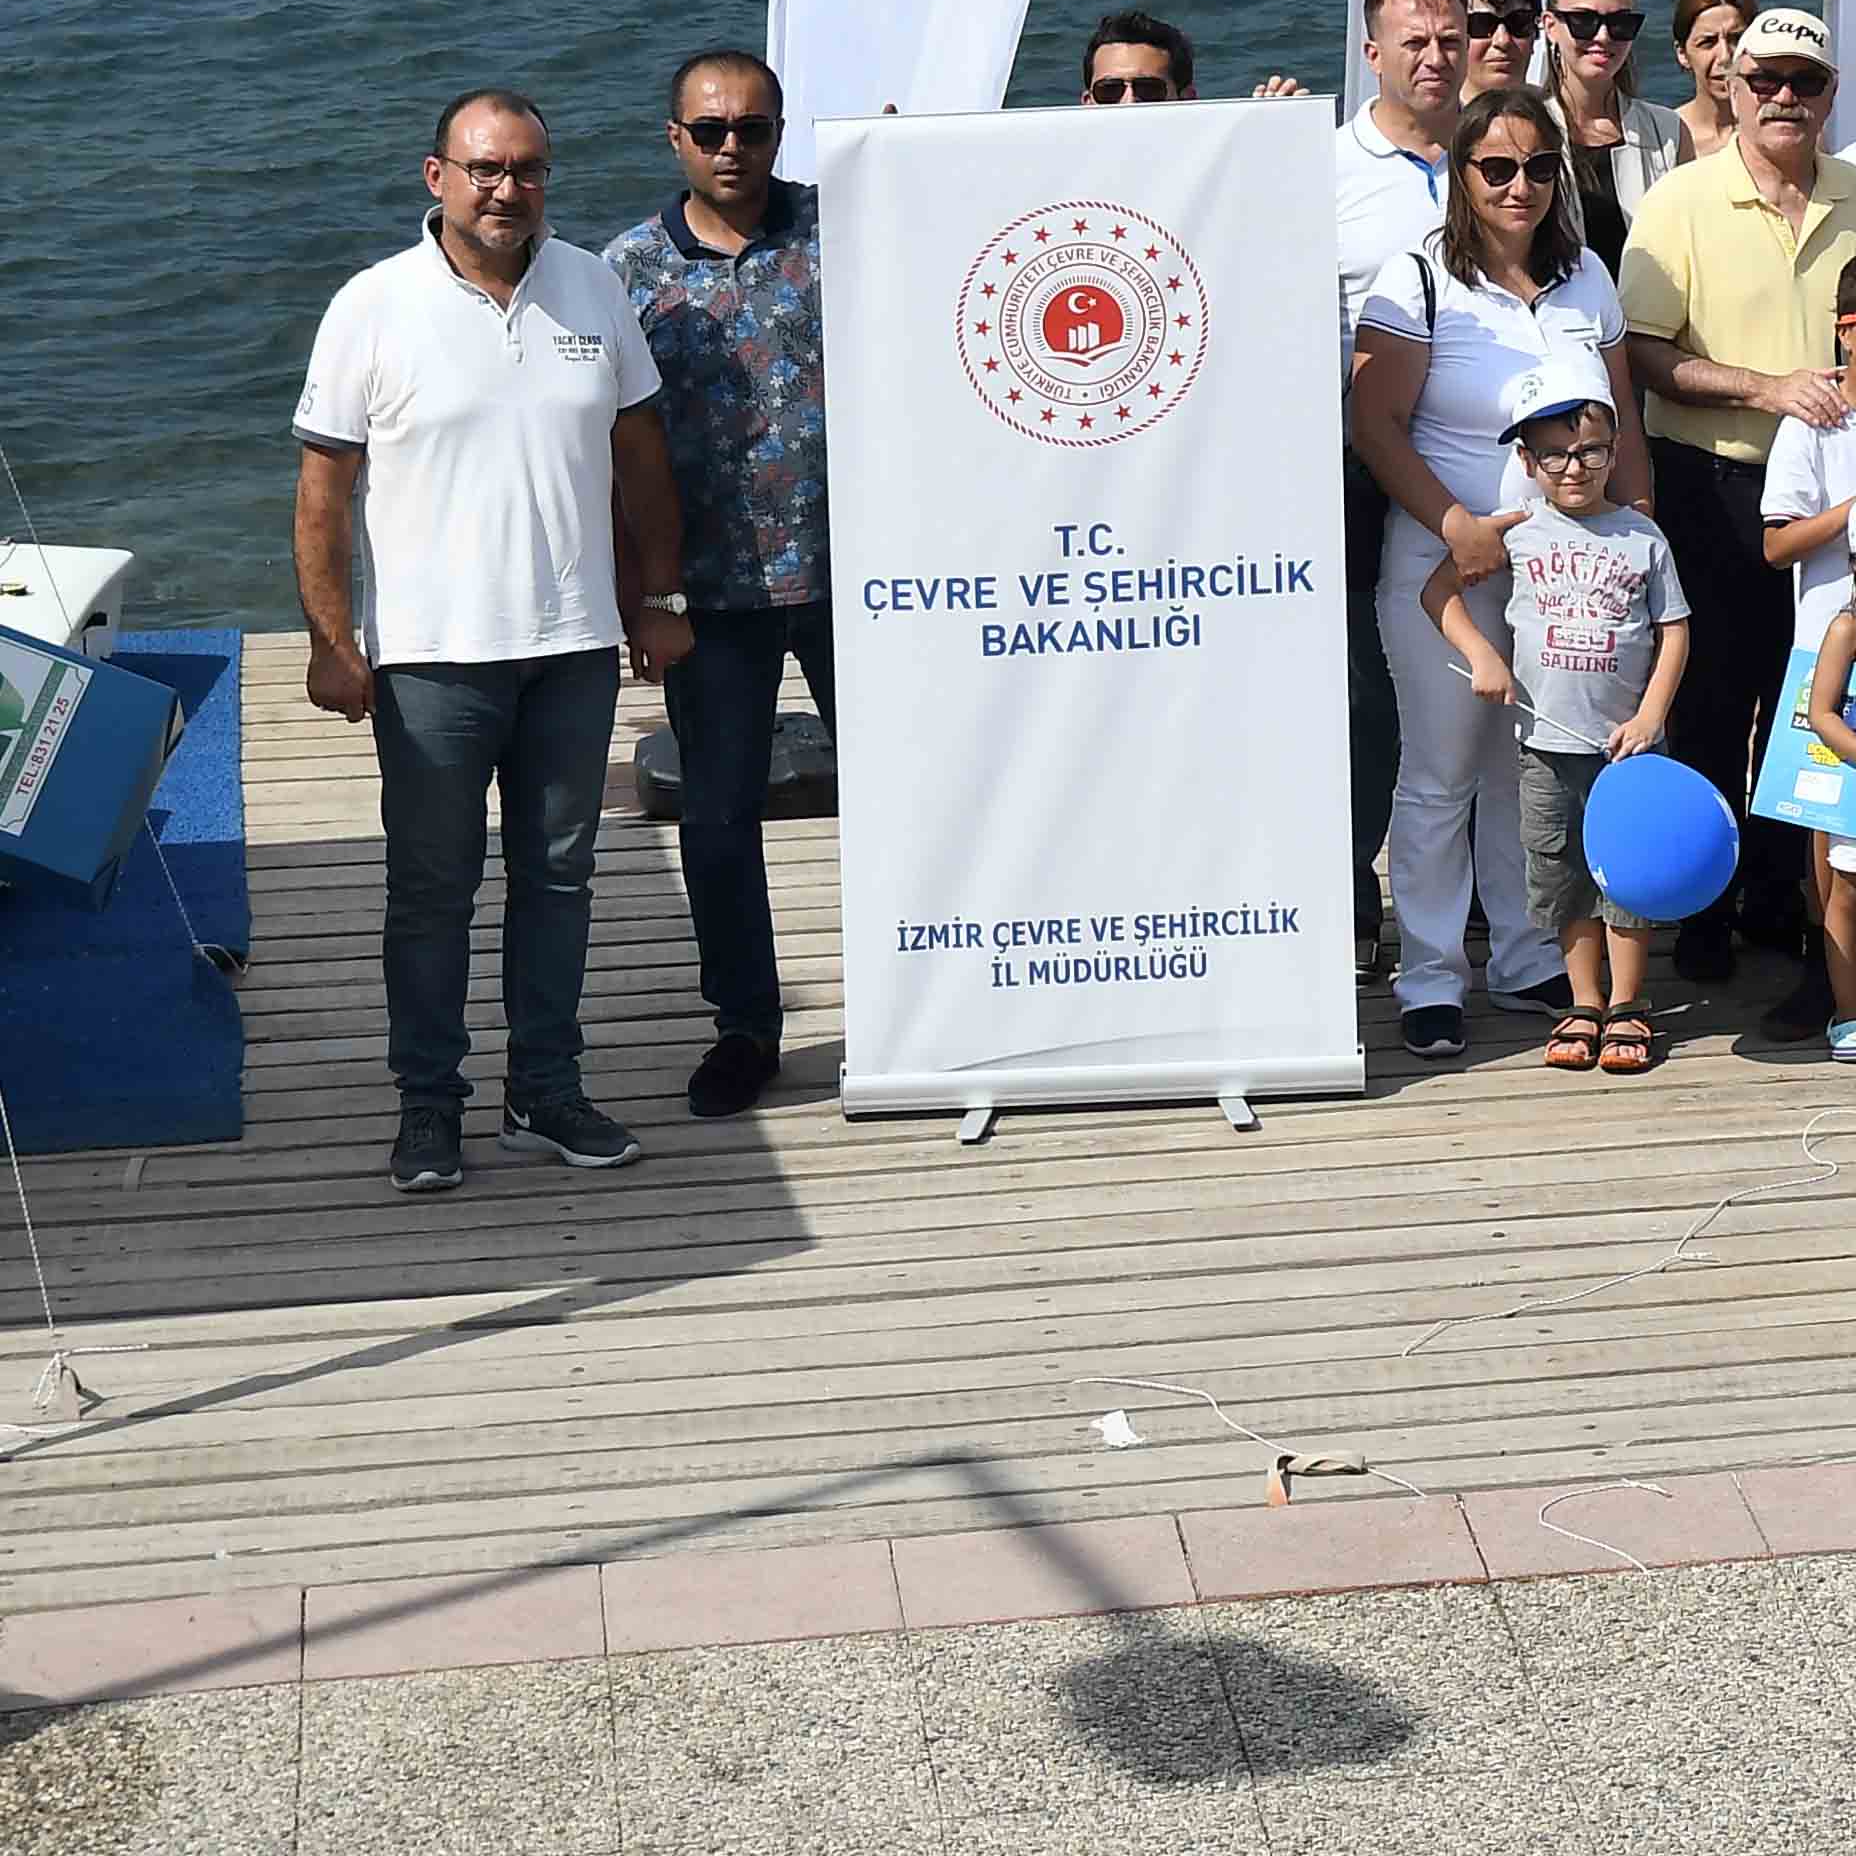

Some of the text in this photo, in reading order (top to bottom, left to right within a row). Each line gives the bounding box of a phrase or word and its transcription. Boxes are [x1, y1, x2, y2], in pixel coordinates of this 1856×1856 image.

[1762, 17, 1825, 49] Capri
[1046, 246, 1095, 272] ÇEVRE
[1100, 248, 1118, 265] VE
[1053, 523, 1125, 558] T.C.
[863, 549, 1315, 619] ÇEVRE VE ŞEHİRCİLİK
[980, 603, 1201, 658] BAKANLIĞI
[1540, 651, 1618, 673] SAILING
[45, 719, 60, 737] 21
[56, 697, 70, 717] 25
[896, 902, 1300, 956] İZMİR ÇEVRE VE ŞEHİRCİLİK
[990, 944, 1208, 989] İL MÜDÜRLÜĞÜ
